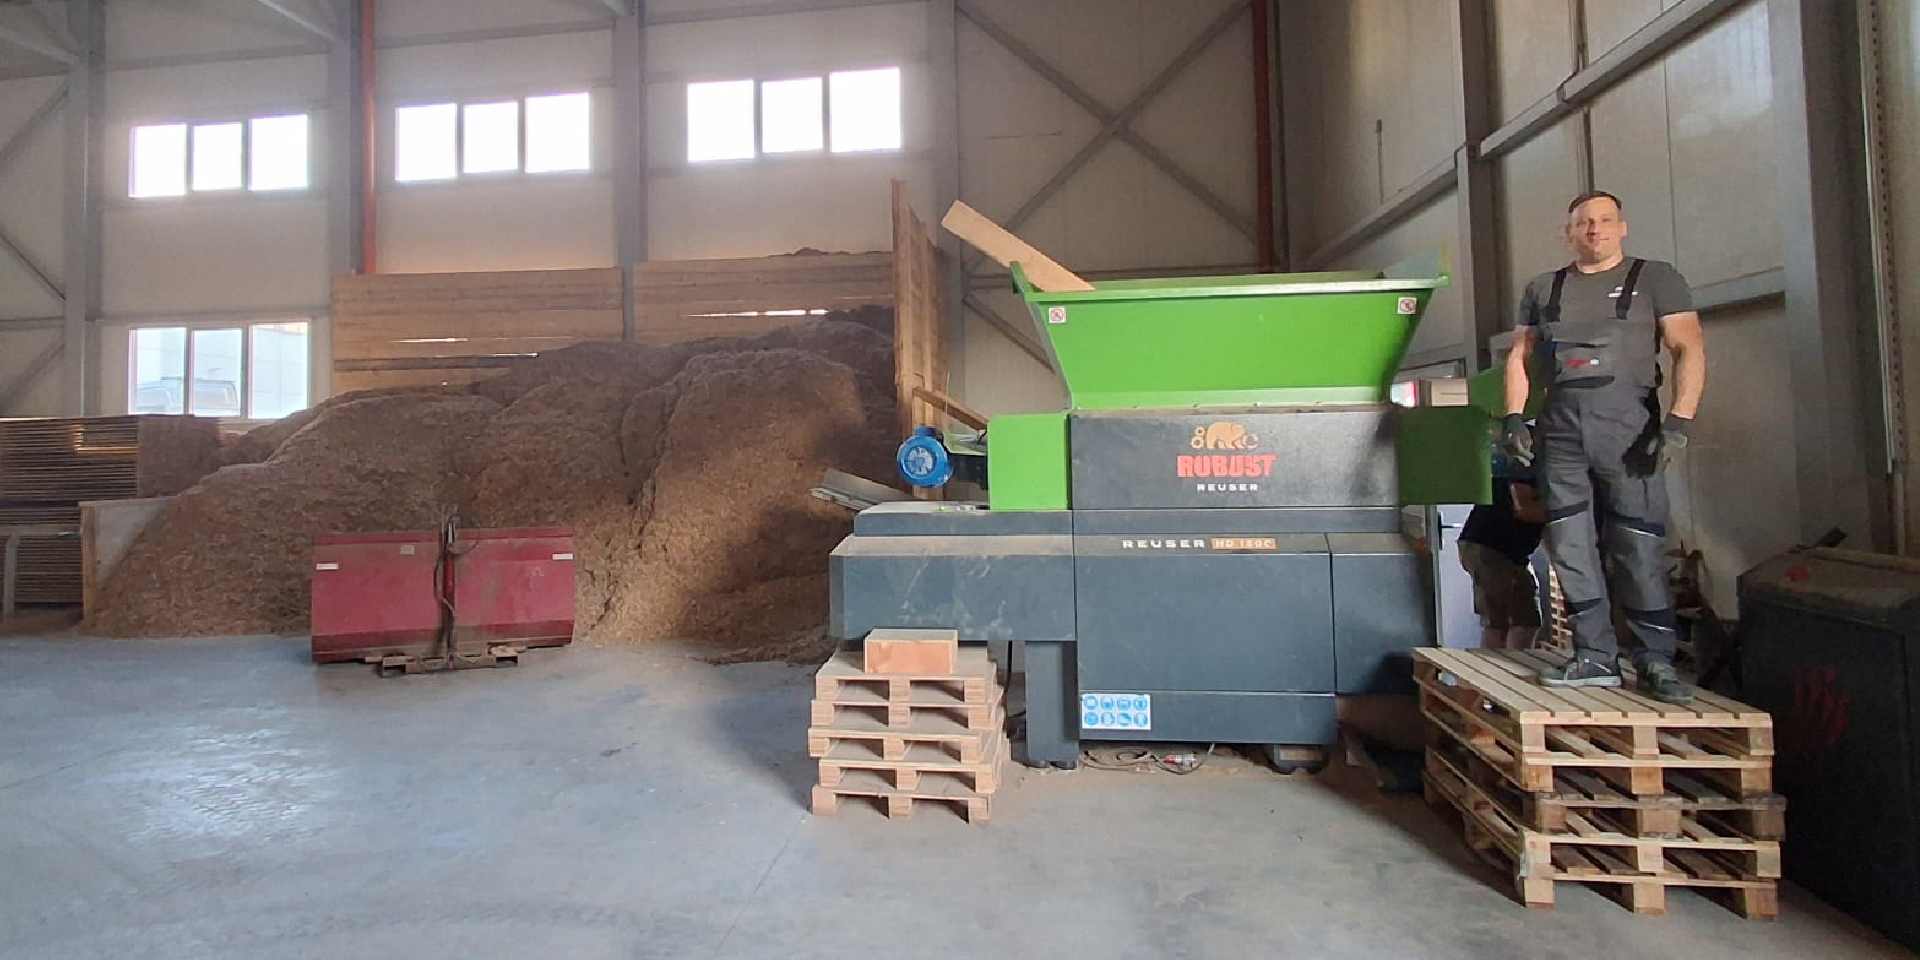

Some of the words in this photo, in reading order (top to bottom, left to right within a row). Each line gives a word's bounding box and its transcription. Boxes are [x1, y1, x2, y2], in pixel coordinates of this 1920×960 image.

[1177, 454, 1276, 478] ROBUST
[1196, 483, 1258, 492] REUSER
[1122, 539, 1205, 548] REUSER
